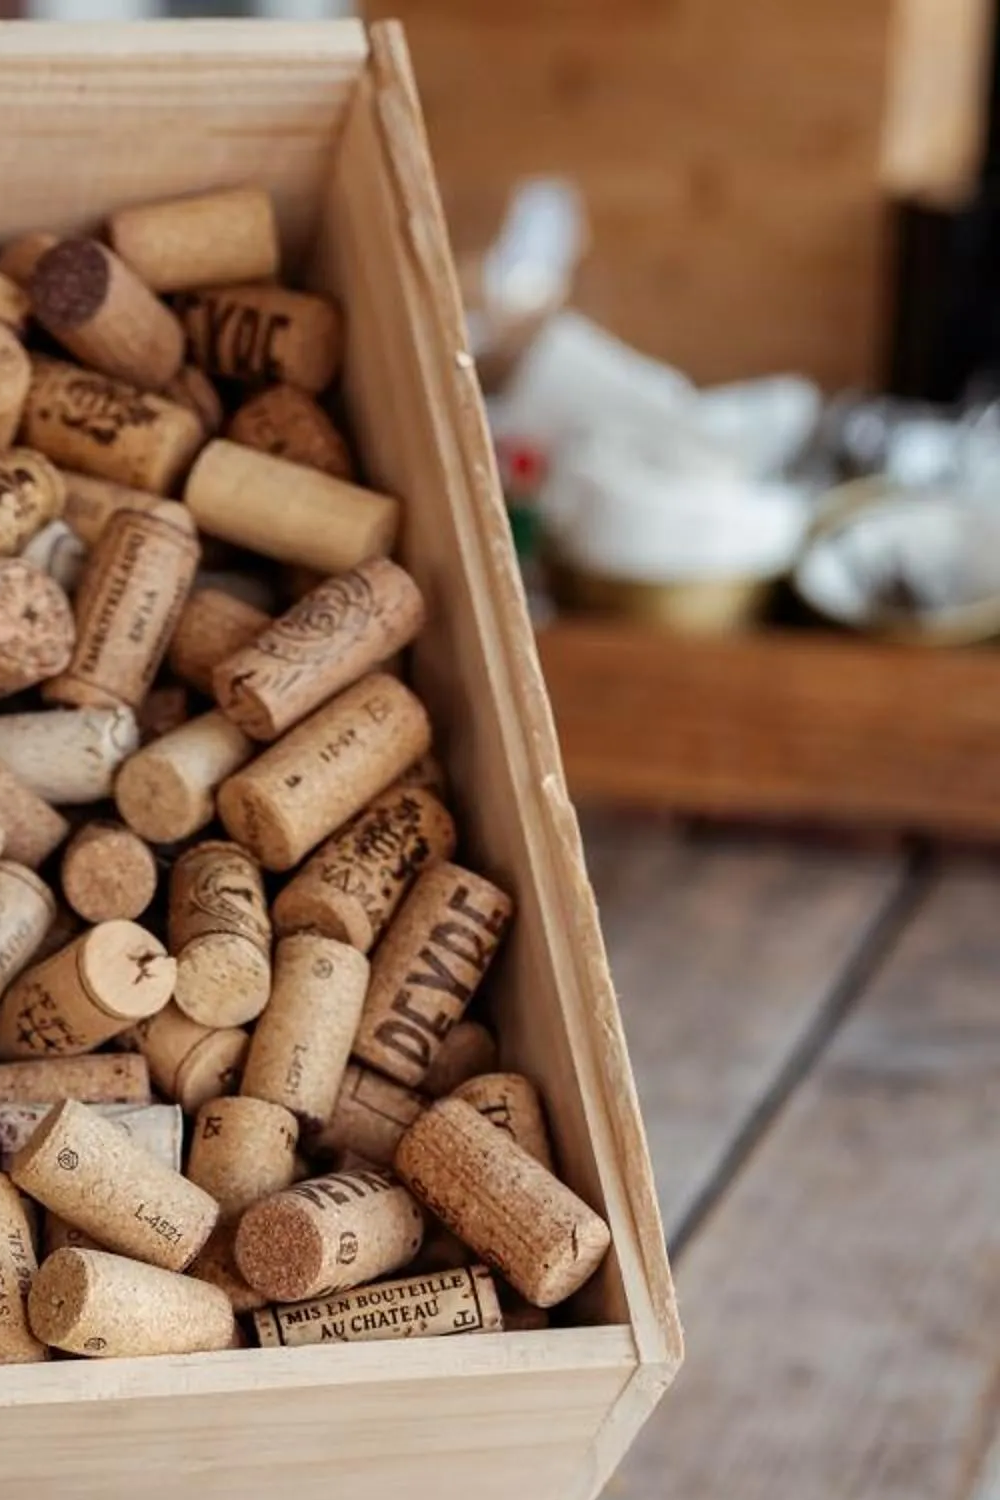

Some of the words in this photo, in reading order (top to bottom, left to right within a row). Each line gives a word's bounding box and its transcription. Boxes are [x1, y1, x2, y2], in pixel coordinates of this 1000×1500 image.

[133, 1203, 185, 1246] L-4521
[284, 1305, 322, 1326] MIS
[327, 1298, 351, 1317] EN
[355, 1274, 466, 1310] BOUTEILLE
[319, 1319, 347, 1341] AU
